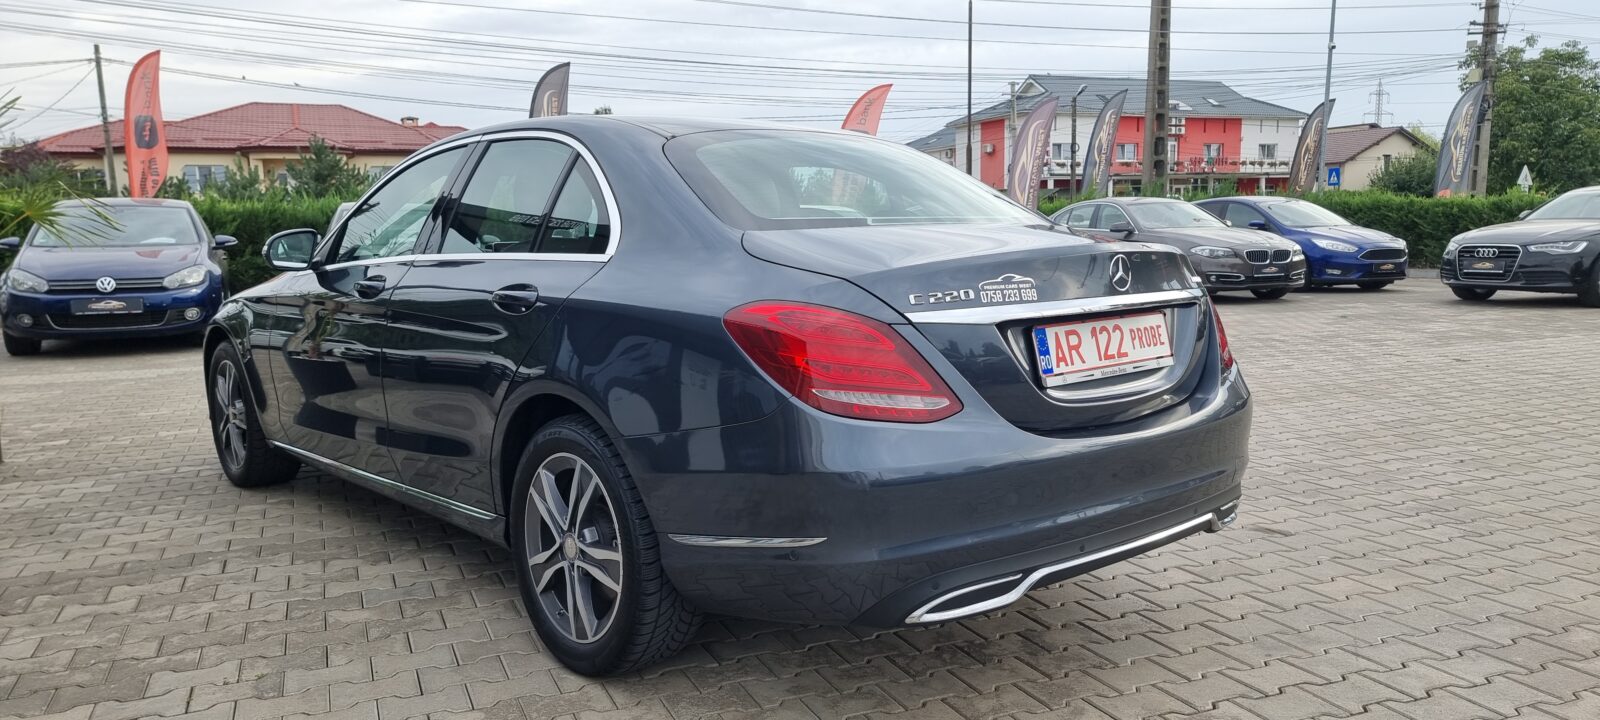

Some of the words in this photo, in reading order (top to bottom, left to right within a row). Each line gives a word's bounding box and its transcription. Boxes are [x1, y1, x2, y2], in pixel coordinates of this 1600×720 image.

[909, 294, 925, 305] C
[928, 289, 975, 304] 220
[980, 291, 1002, 303] 0758
[1004, 290, 1020, 302] 233
[1021, 289, 1038, 301] 699
[1055, 329, 1086, 368] AR
[1091, 323, 1129, 361] 122
[1129, 324, 1165, 350] PROBE
[1040, 355, 1052, 369] RO
[1100, 367, 1127, 376] Mercedes-Benz
